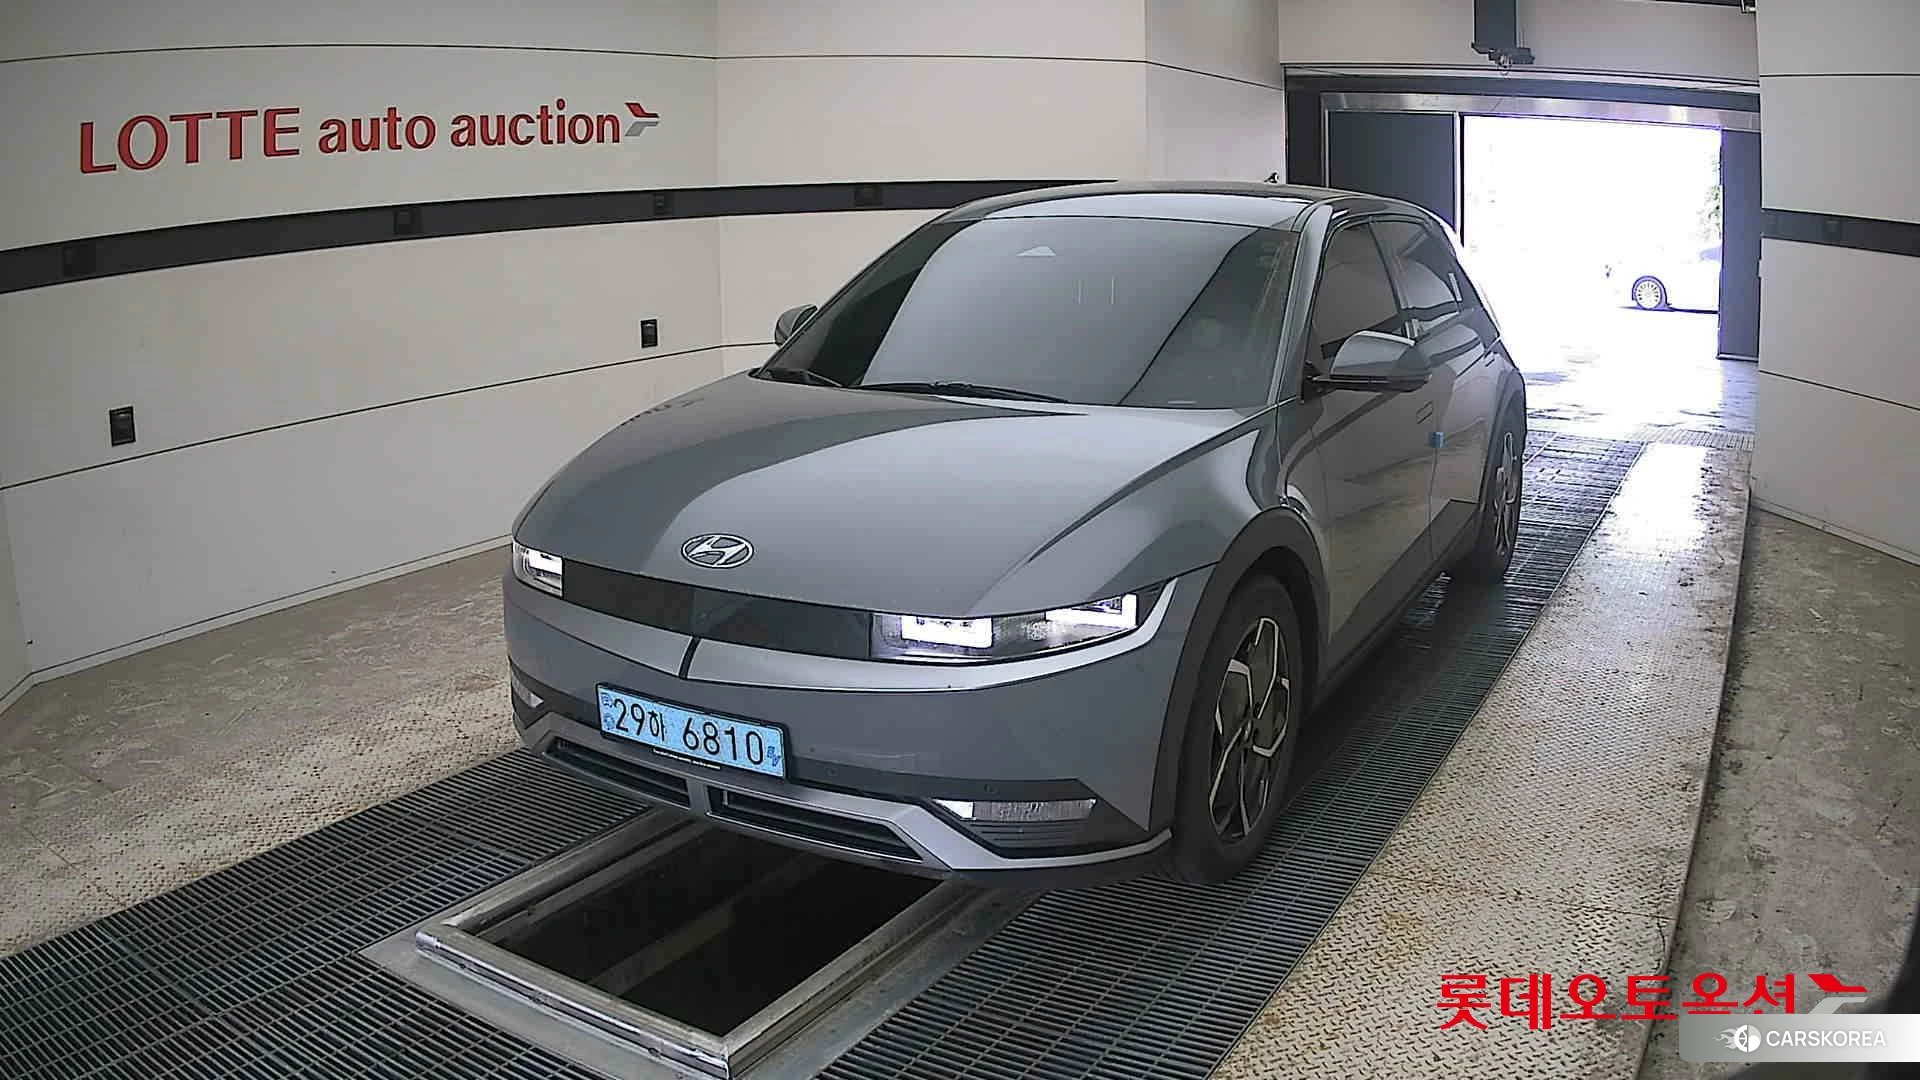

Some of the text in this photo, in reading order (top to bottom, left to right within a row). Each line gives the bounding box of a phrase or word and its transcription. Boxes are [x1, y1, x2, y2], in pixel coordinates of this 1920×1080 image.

[79, 99, 622, 175] LOTTE auto auction
[614, 698, 667, 742] 29하
[682, 717, 765, 766] 6810
